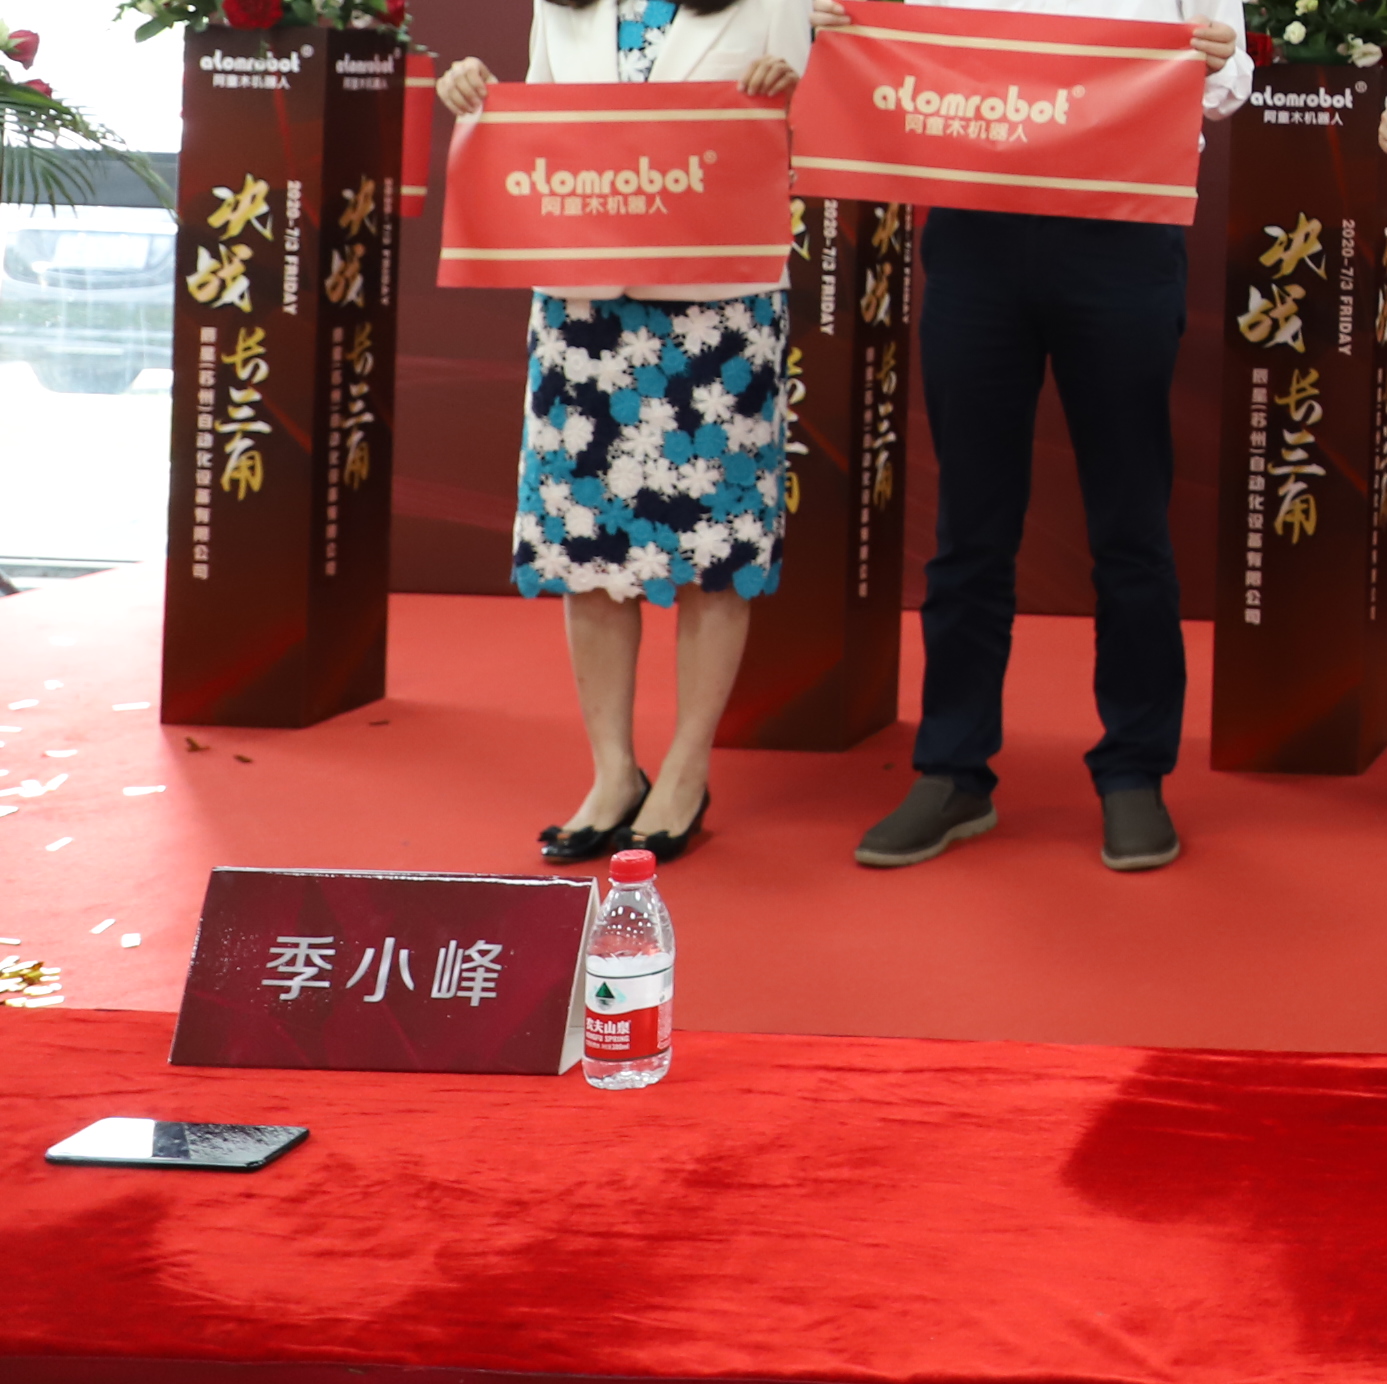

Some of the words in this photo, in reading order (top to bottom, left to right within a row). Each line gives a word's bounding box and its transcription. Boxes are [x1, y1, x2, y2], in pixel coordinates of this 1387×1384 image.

[873, 75, 1069, 125] atomrobot
[1251, 85, 1353, 109] atomrobot
[1263, 109, 1343, 126] 阿童木机器人
[905, 113, 1028, 143] 阿童木机器人
[505, 156, 704, 196] atomrobot
[541, 194, 668, 216] 阿童木机器人
[282, 254, 300, 315] FRIDAY
[1237, 211, 1328, 354] 决战
[1339, 219, 1355, 291] 2020-7/3
[820, 274, 836, 336] FRIDAY
[1338, 296, 1354, 356] FRIDAY
[1267, 367, 1327, 545] 长三角
[262, 935, 502, 1007] 季小峰
